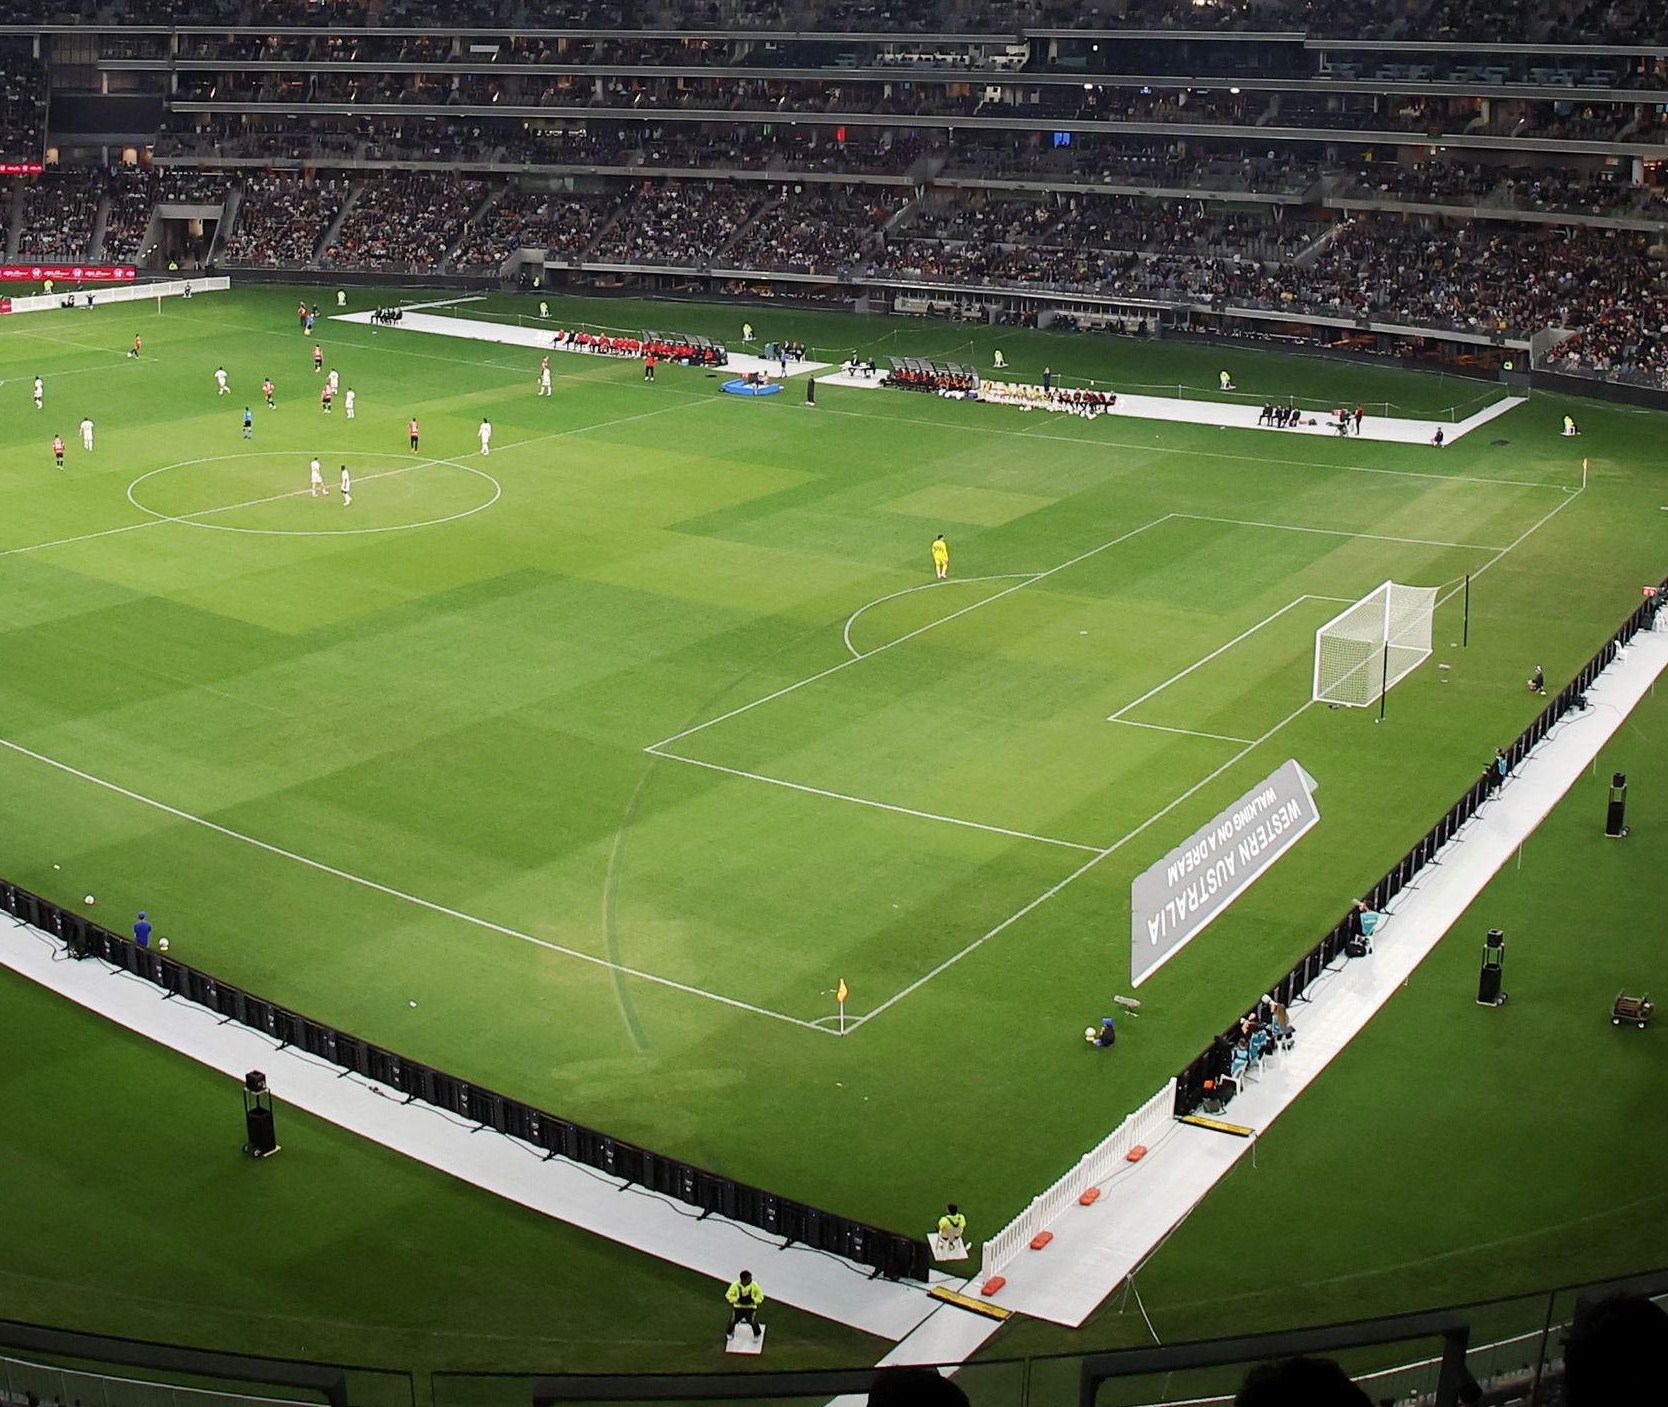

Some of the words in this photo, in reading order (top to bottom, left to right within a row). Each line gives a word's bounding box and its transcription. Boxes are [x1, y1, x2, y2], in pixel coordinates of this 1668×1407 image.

[1233, 787, 1277, 831] WALKING
[1238, 798, 1302, 865] WESTERN
[1207, 831, 1217, 851] A
[1217, 825, 1234, 846] ON
[1167, 839, 1209, 887] DREAM
[1147, 850, 1235, 945] AUSTRALIA
